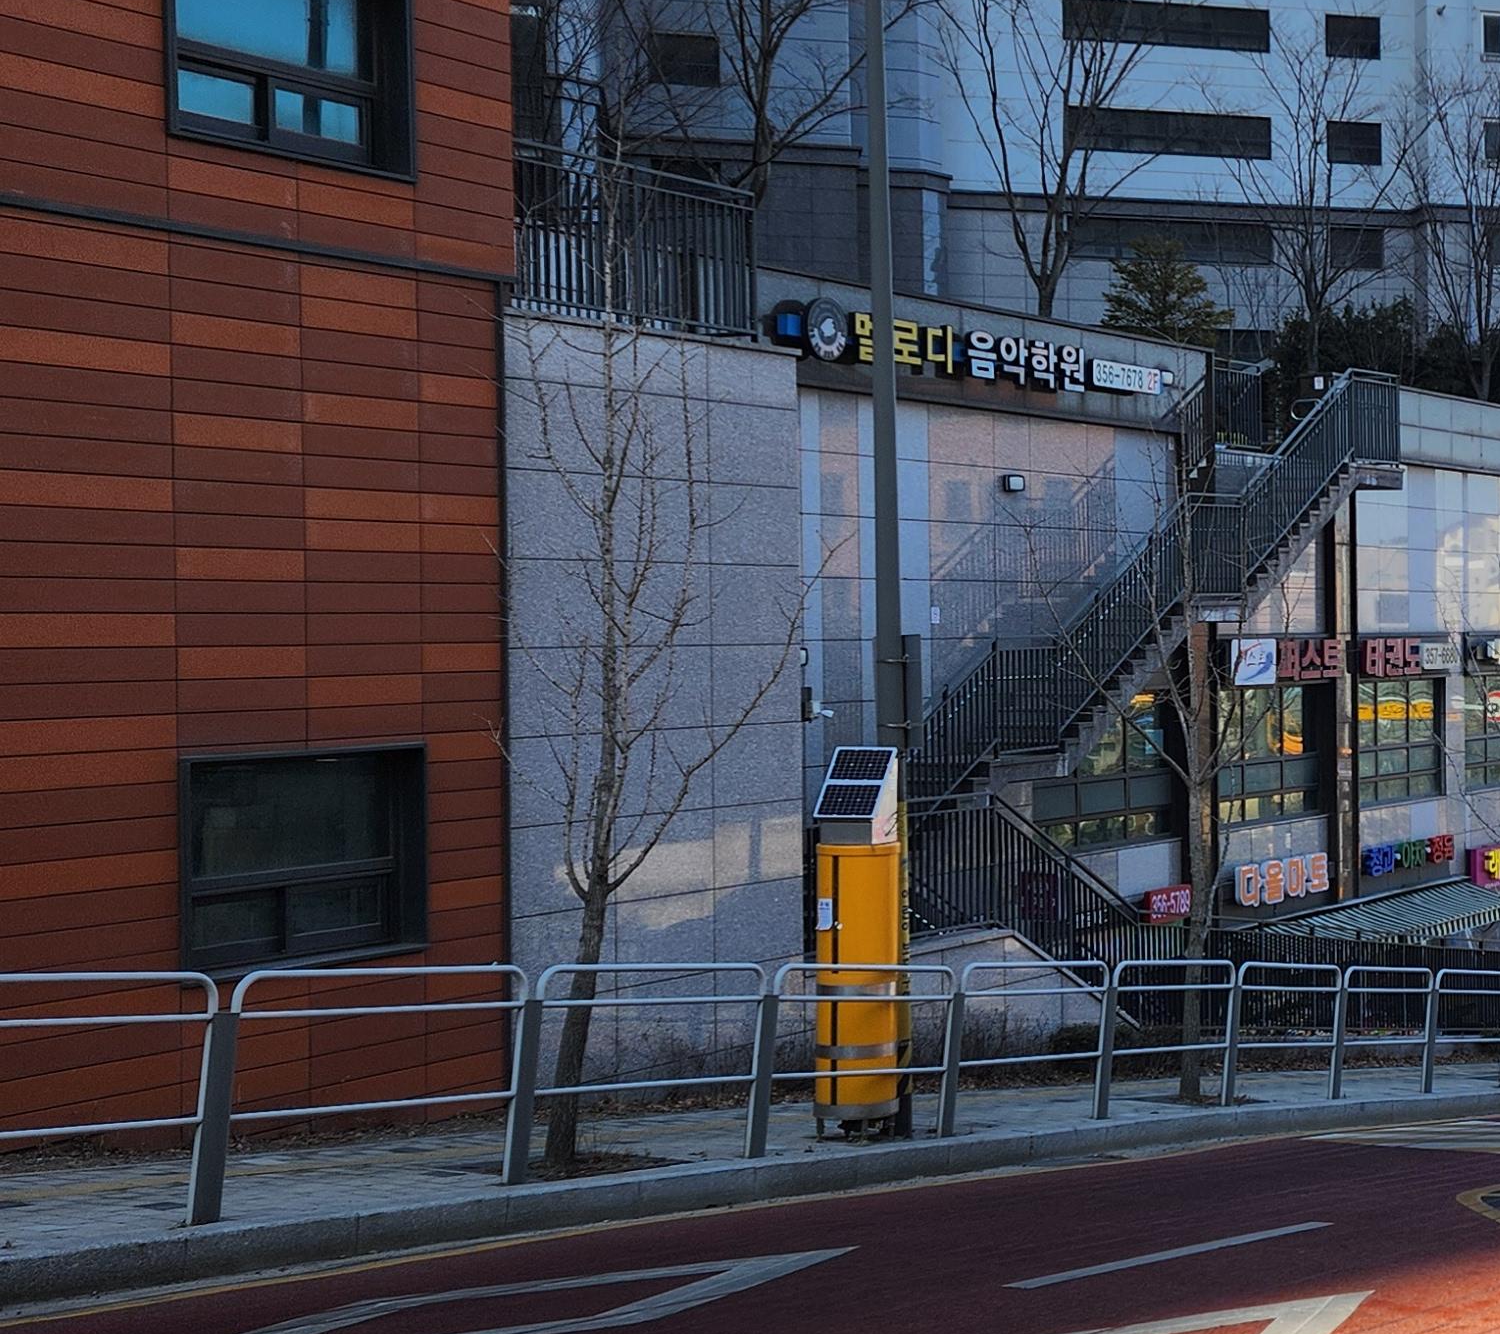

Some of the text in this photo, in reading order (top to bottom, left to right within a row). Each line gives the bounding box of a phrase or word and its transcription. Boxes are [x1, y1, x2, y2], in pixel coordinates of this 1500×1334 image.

[967, 330, 1085, 394] 음악학원
[1095, 364, 1159, 391] 356-7678 2F
[1366, 637, 1422, 677] 태권도
